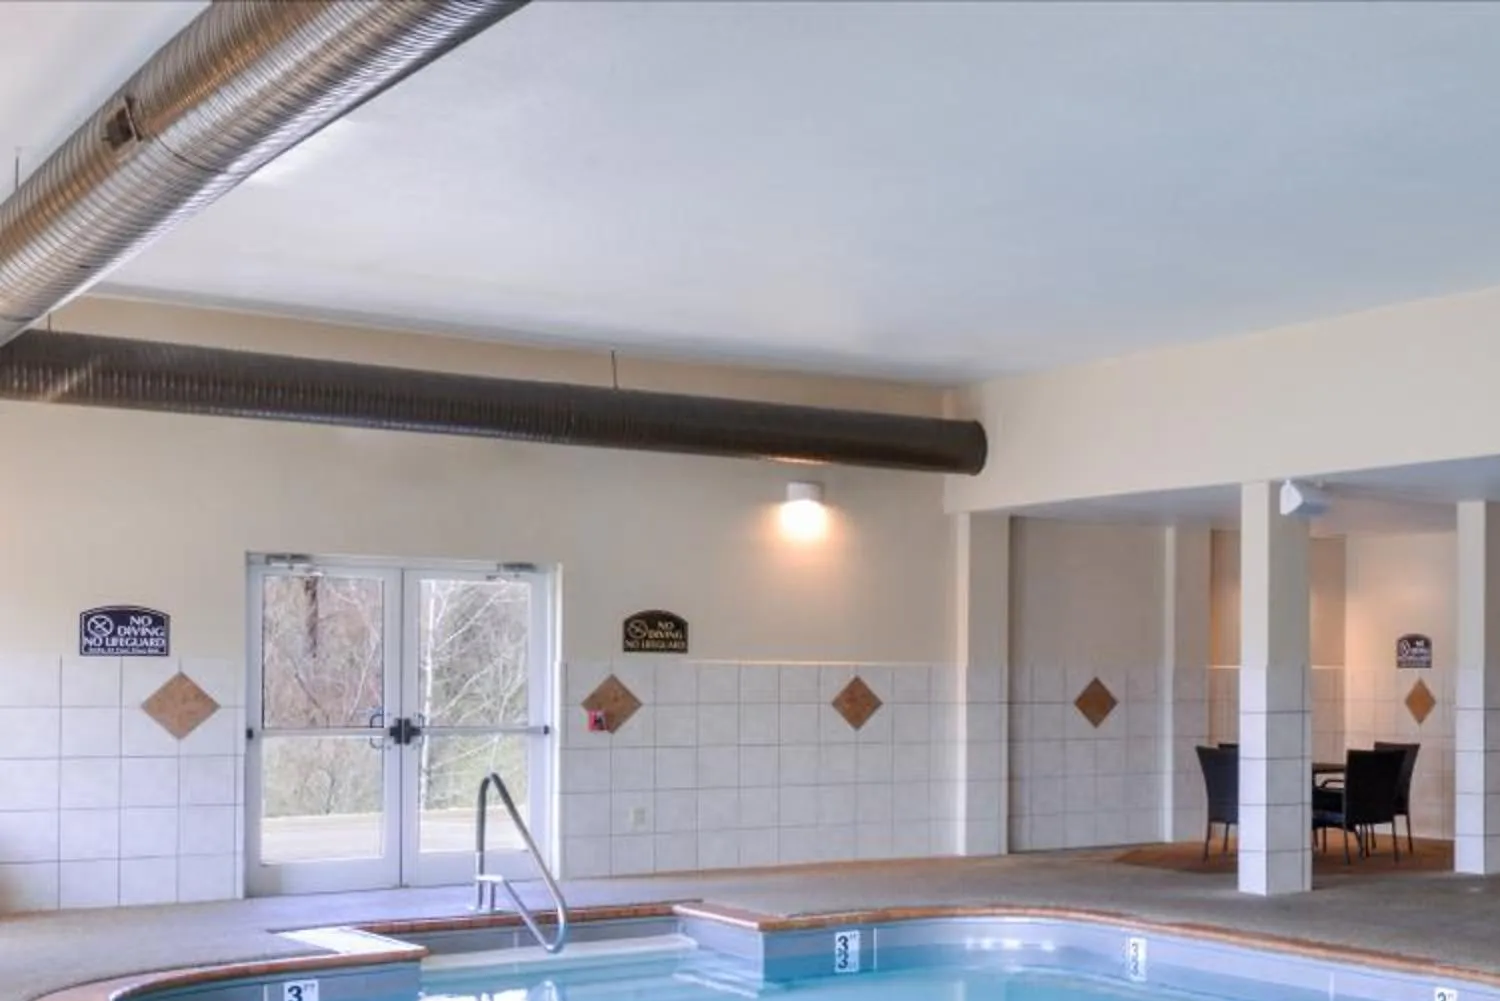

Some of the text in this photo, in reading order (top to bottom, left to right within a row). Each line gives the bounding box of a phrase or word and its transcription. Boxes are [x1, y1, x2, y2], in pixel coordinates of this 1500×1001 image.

[129, 615, 153, 626] NO
[117, 625, 164, 637] DIVING
[84, 637, 164, 647] NO LIFEGUARD
[837, 935, 849, 951] 3
